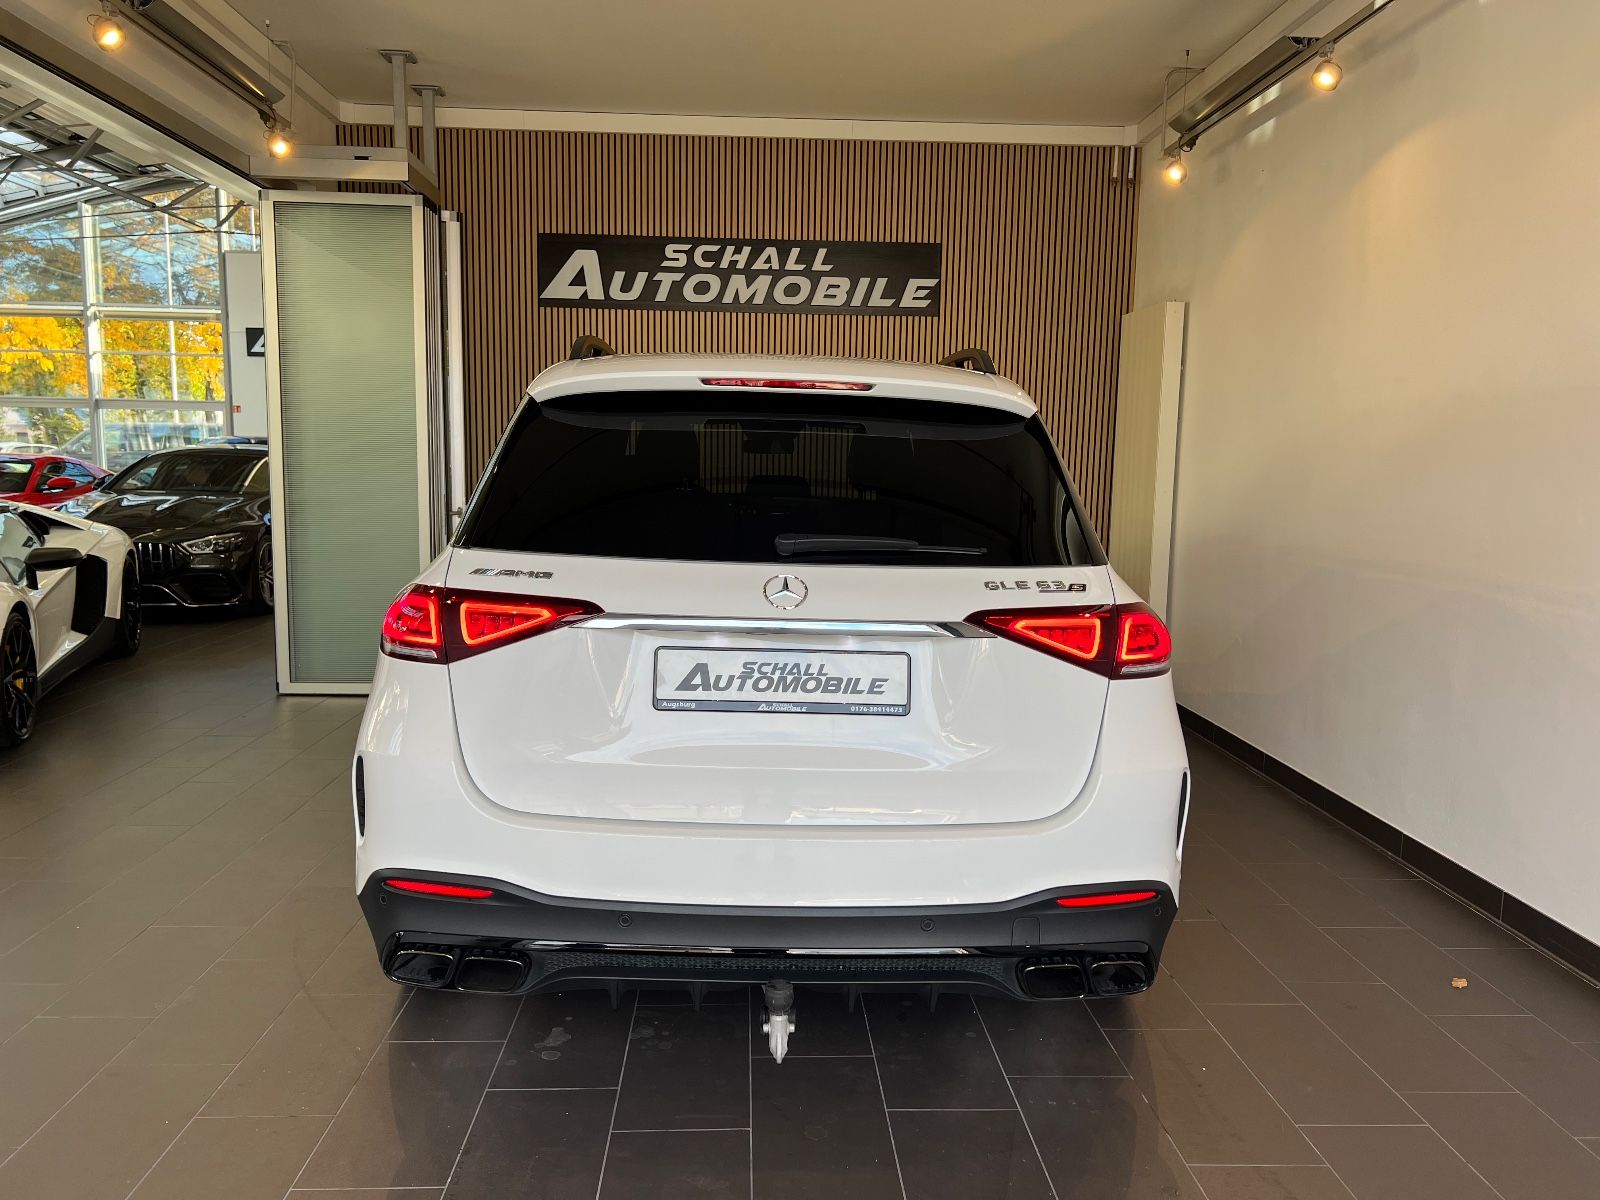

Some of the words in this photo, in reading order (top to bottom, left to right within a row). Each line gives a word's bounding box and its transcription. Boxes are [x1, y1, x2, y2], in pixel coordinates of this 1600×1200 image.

[660, 243, 835, 272] SCHALL
[539, 249, 940, 308] AUTOMOBILE
[492, 568, 554, 579] AMG
[983, 580, 1031, 591] GLE
[739, 661, 828, 677] SCHALL
[674, 662, 890, 695] AUTOMOBILE
[661, 701, 696, 709] Augsburg
[757, 703, 808, 712] AUTOMOBILE
